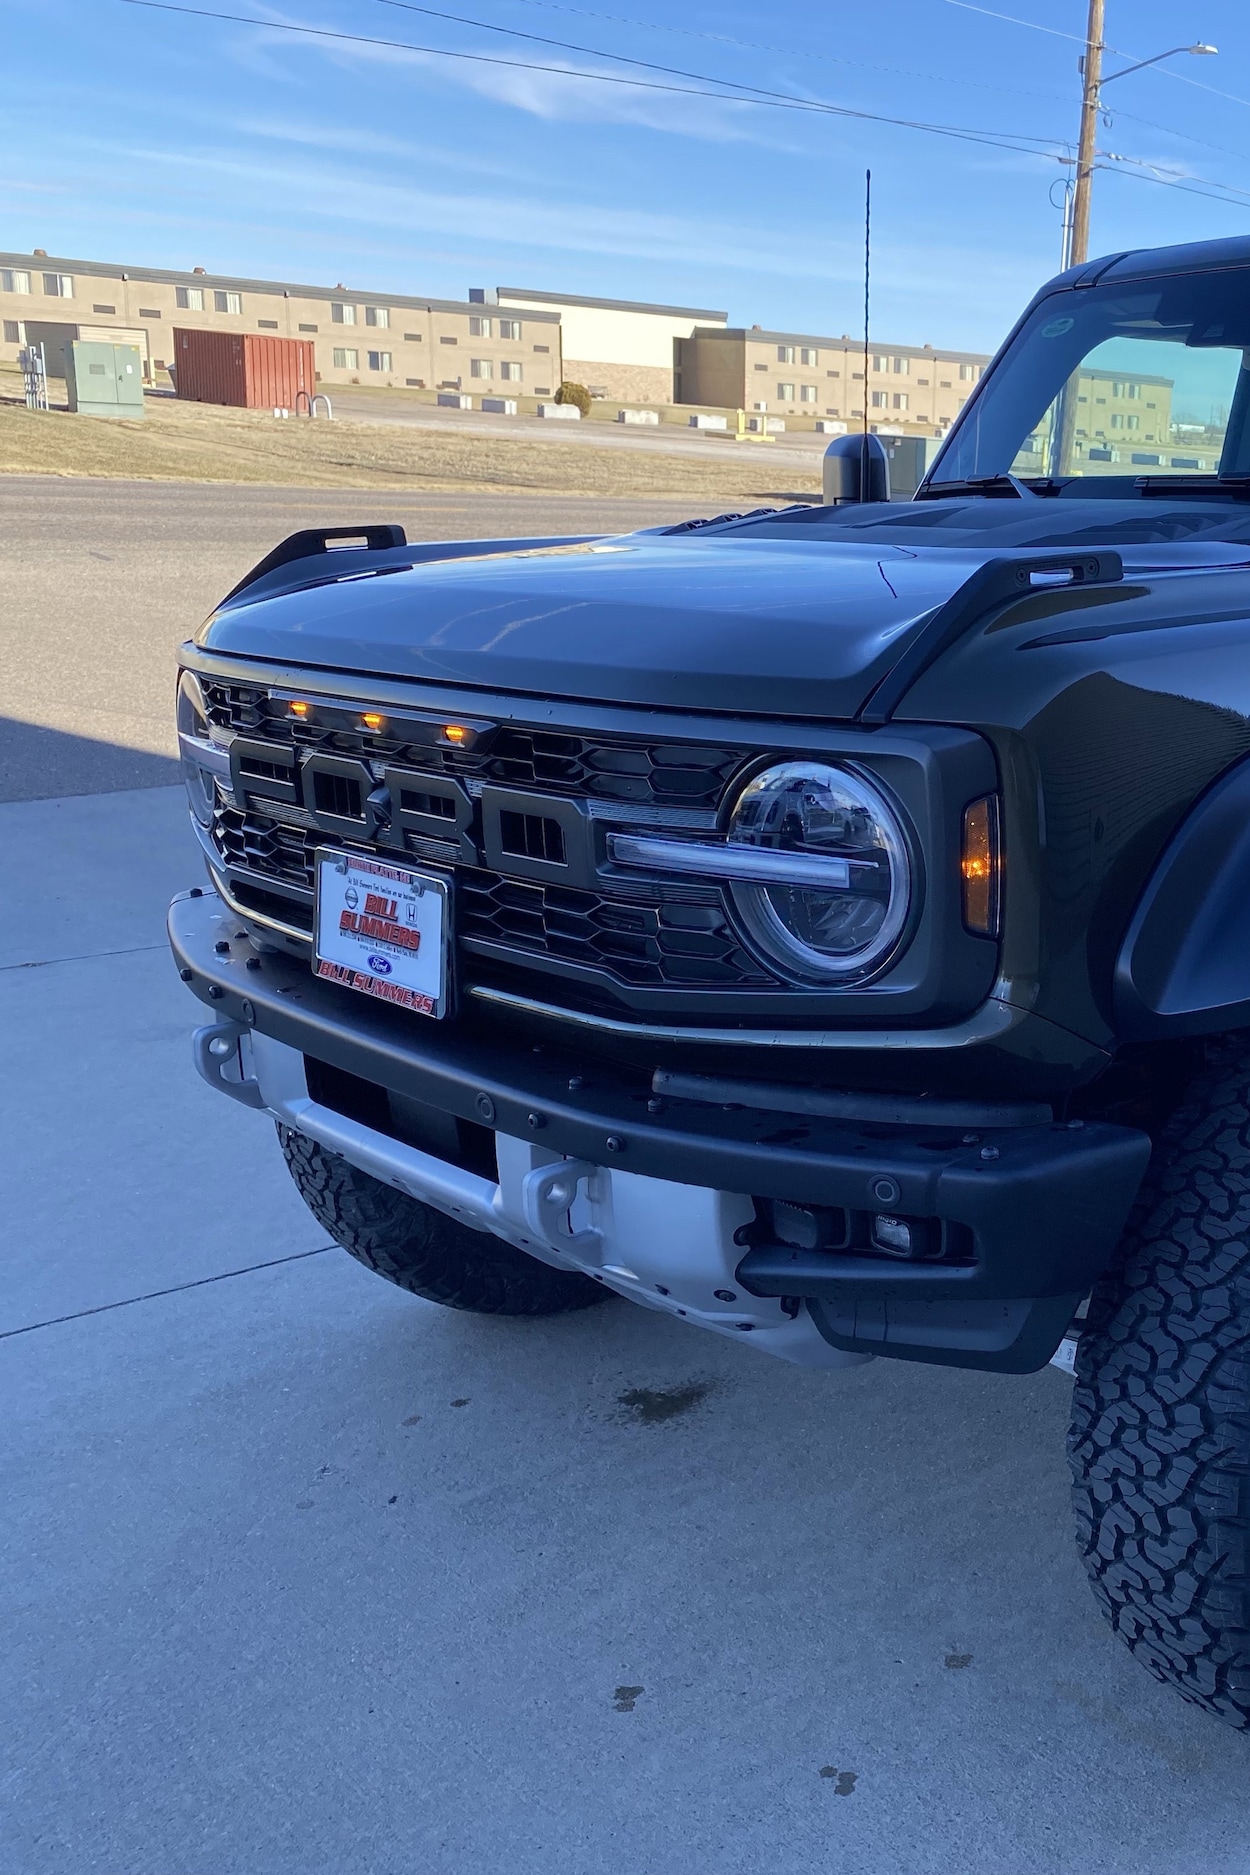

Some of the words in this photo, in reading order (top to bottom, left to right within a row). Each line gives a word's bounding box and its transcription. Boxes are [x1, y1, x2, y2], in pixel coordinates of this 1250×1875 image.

[229, 734, 598, 886] FORD
[364, 893, 398, 921] BILL
[340, 910, 421, 952] SUMMERS
[319, 961, 350, 984] BILL
[353, 972, 434, 1014] SUMMERS
